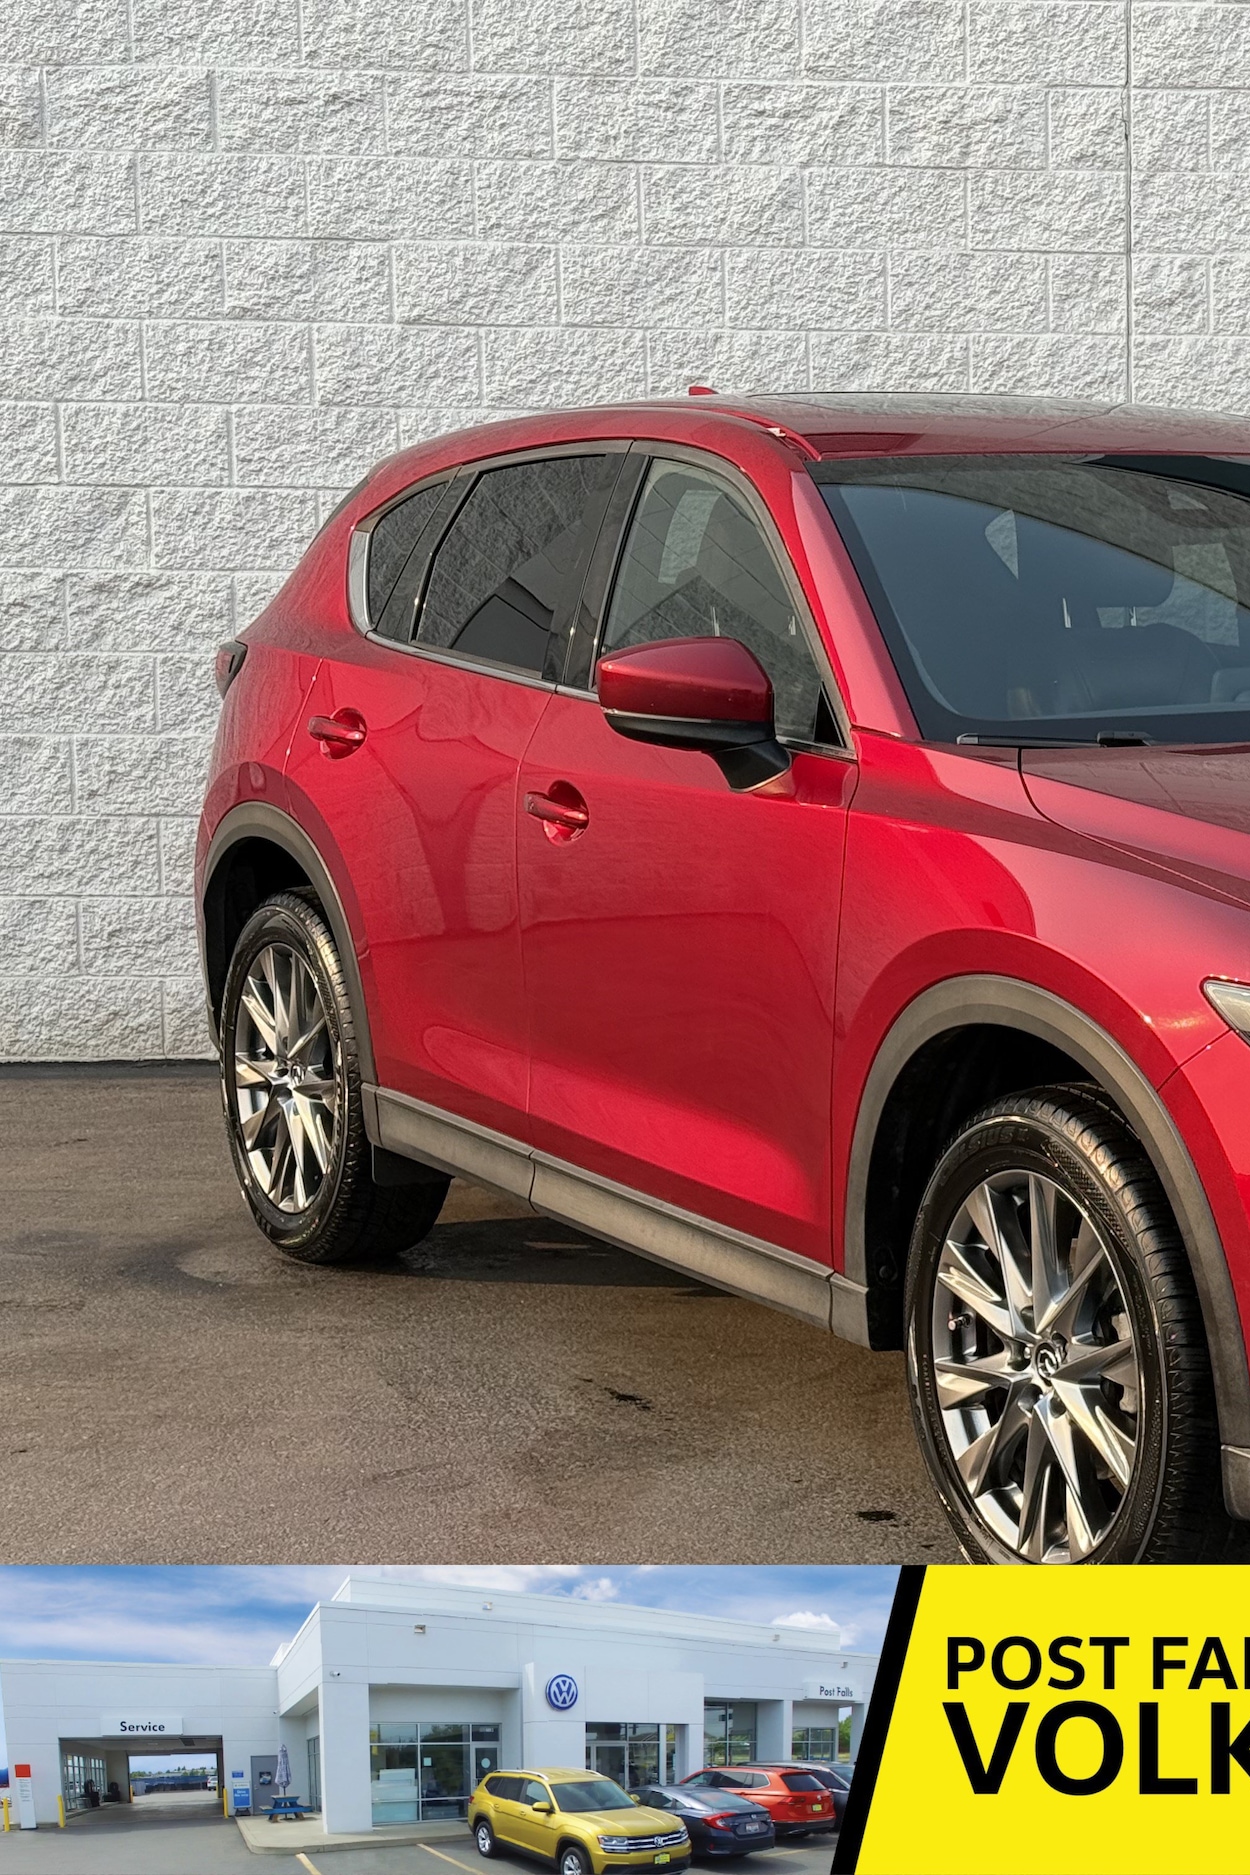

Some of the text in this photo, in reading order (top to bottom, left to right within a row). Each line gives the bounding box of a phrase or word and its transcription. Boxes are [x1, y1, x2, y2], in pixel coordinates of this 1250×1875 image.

[819, 1686, 853, 1697] Post Falls
[119, 1720, 166, 1732] Service
